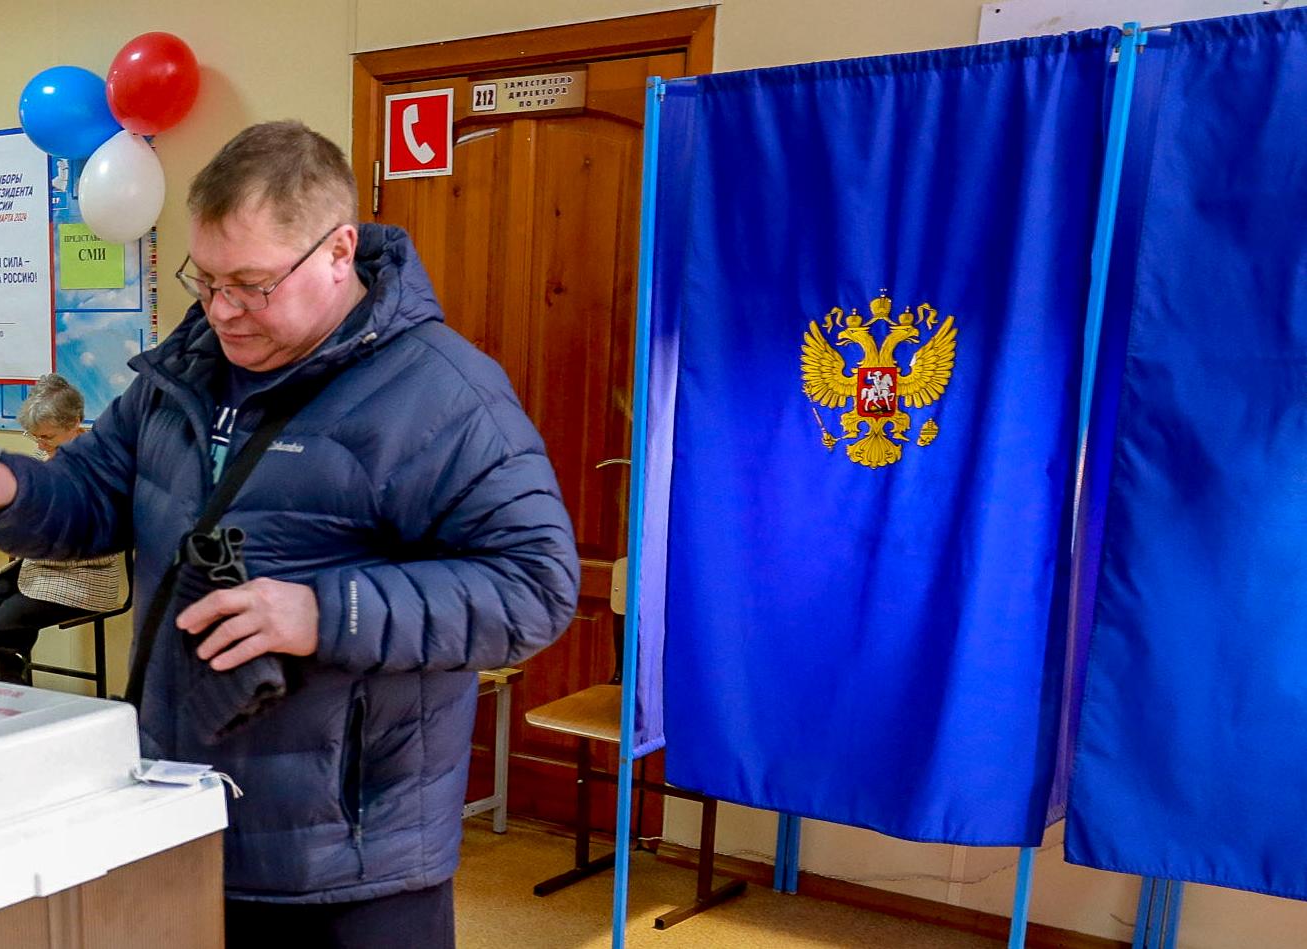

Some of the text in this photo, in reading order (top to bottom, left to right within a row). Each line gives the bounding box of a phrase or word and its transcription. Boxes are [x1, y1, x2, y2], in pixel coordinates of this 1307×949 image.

[504, 77, 573, 89] ЗАМЕСТИТЕЛЬ
[475, 90, 494, 106] 212
[508, 88, 568, 100] ДИРЕКТОРА
[518, 100, 532, 108] ПО
[13, 212, 27, 222] 2024
[78, 248, 106, 262] СМИ
[3, 256, 23, 268] СИЛА
[3, 272, 38, 284] РОССИЮ!
